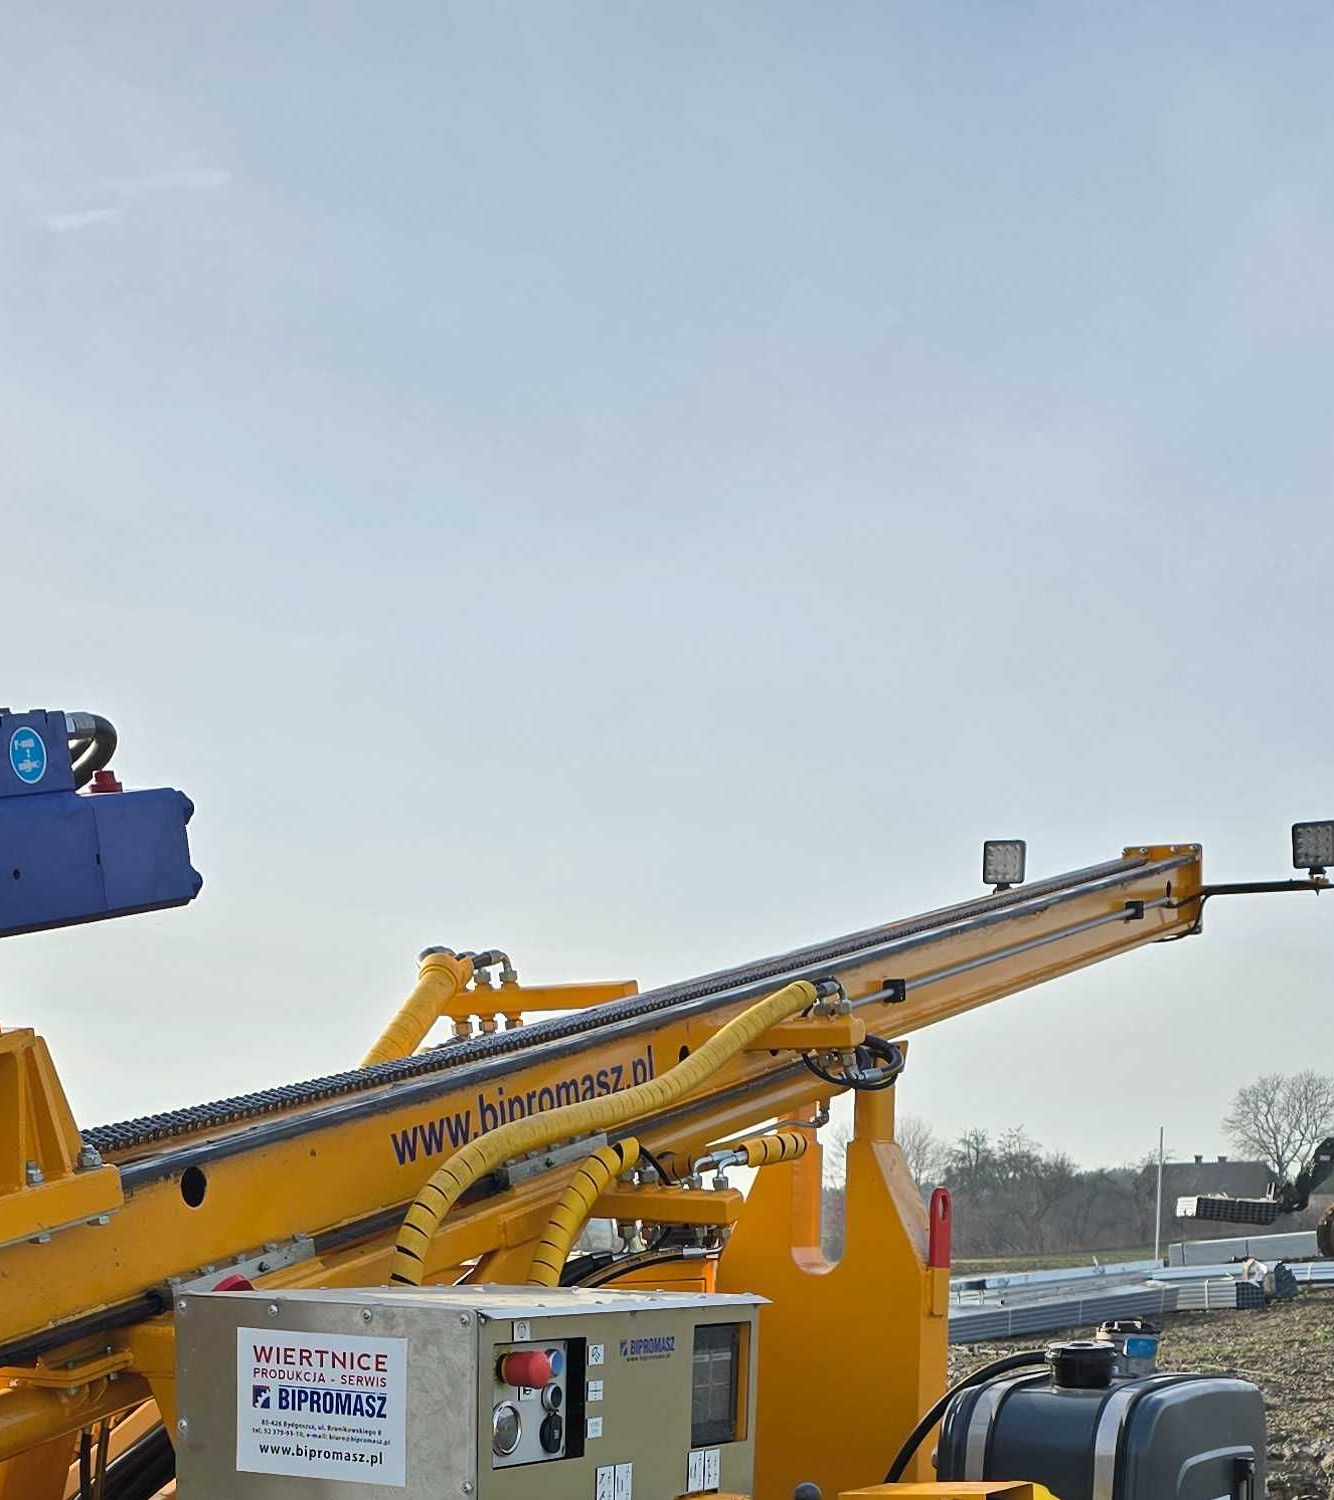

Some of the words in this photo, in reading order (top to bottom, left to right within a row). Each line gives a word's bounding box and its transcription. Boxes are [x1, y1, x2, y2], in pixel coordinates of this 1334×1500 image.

[253, 1345, 388, 1373] WIERTNICE
[253, 1367, 326, 1384] PRODUKCJA
[340, 1374, 387, 1388] SERWIS
[278, 1387, 387, 1419] BIPROMASZ
[259, 1444, 383, 1467] www.bipromasz.pl
